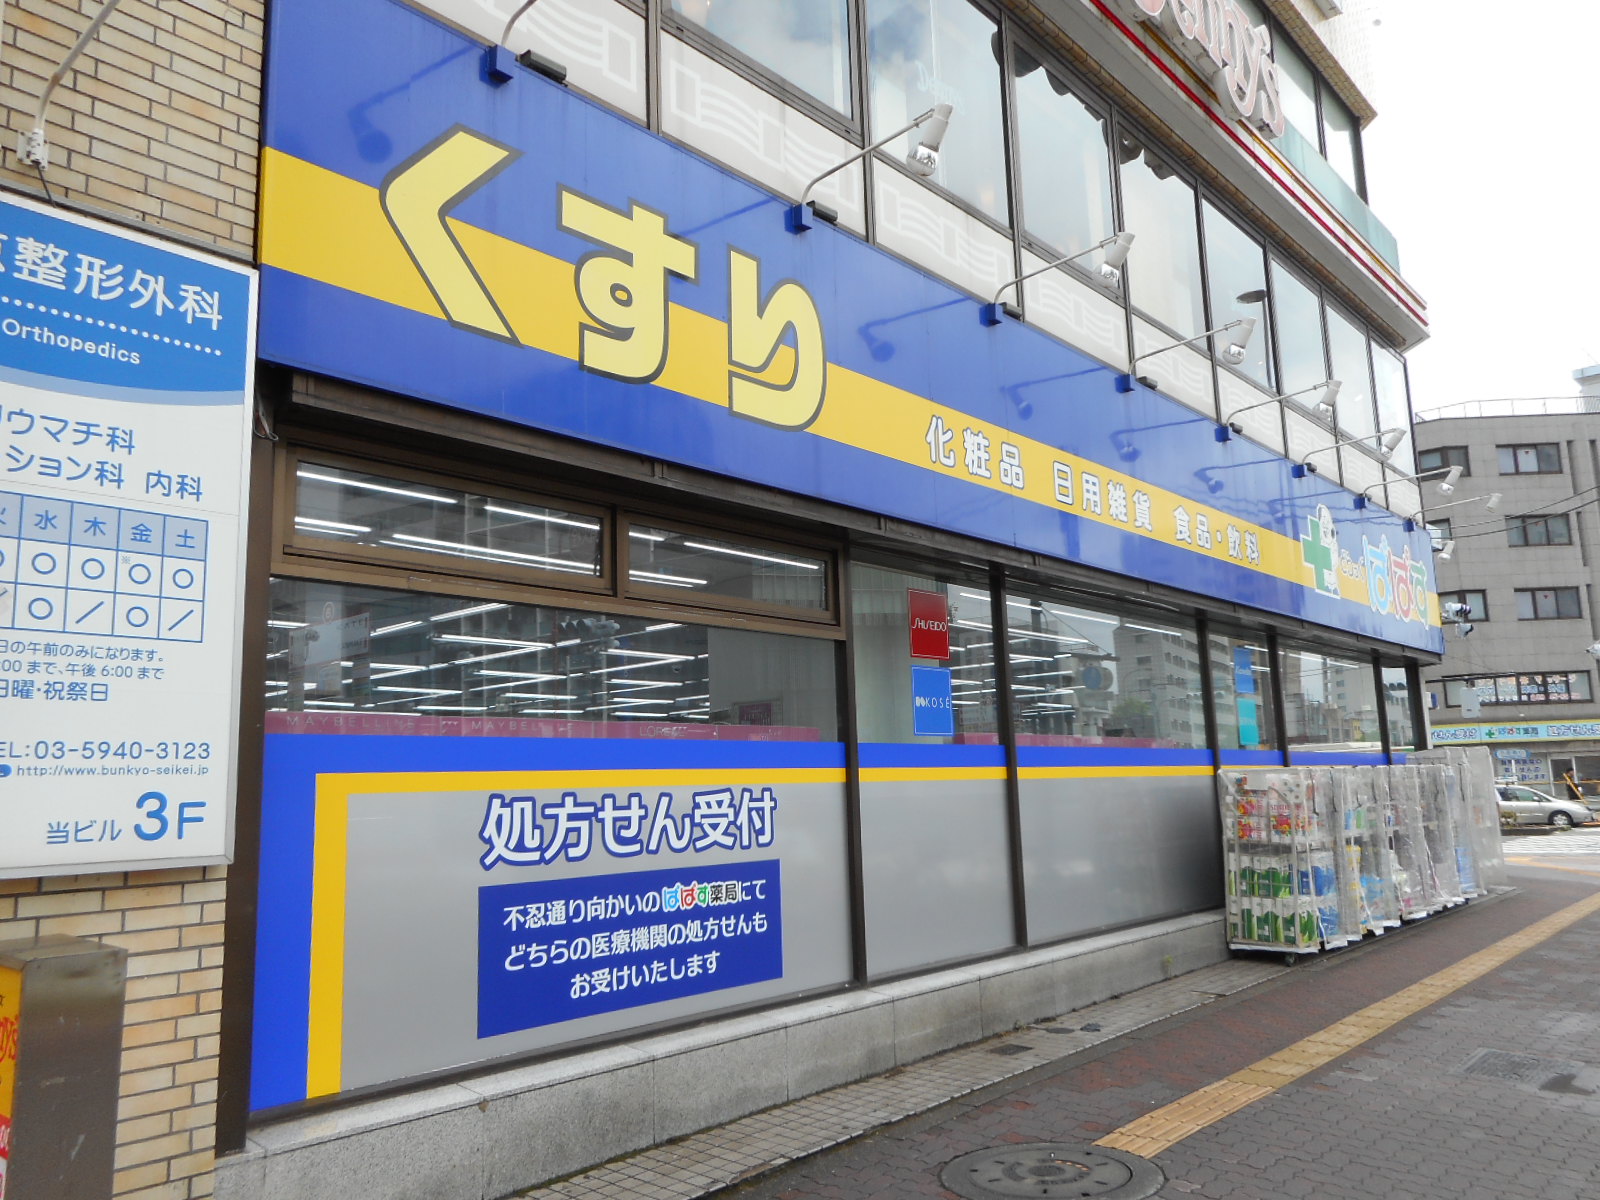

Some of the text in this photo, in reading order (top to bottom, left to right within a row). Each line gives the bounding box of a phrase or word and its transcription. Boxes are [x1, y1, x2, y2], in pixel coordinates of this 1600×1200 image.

[0, 233, 222, 331] 整形外科
[379, 123, 827, 431] くすり
[2, 319, 141, 365] Orthopedics
[145, 471, 203, 502] 内科
[925, 415, 1025, 490] 化粧品
[1053, 460, 1153, 532] 日用雑貨
[34, 510, 197, 550] 水 木 金 土
[912, 617, 947, 631] SHISEIDO
[101, 665, 133, 678] 6:00
[17, 764, 209, 777] http://www.bunkyo-seikei.jp
[47, 791, 206, 844] 当ビル 3F
[480, 787, 778, 871] 処方せん受付
[504, 912, 768, 971] どちらの医療機関の処方せんも
[569, 950, 721, 999] お受けいたします
